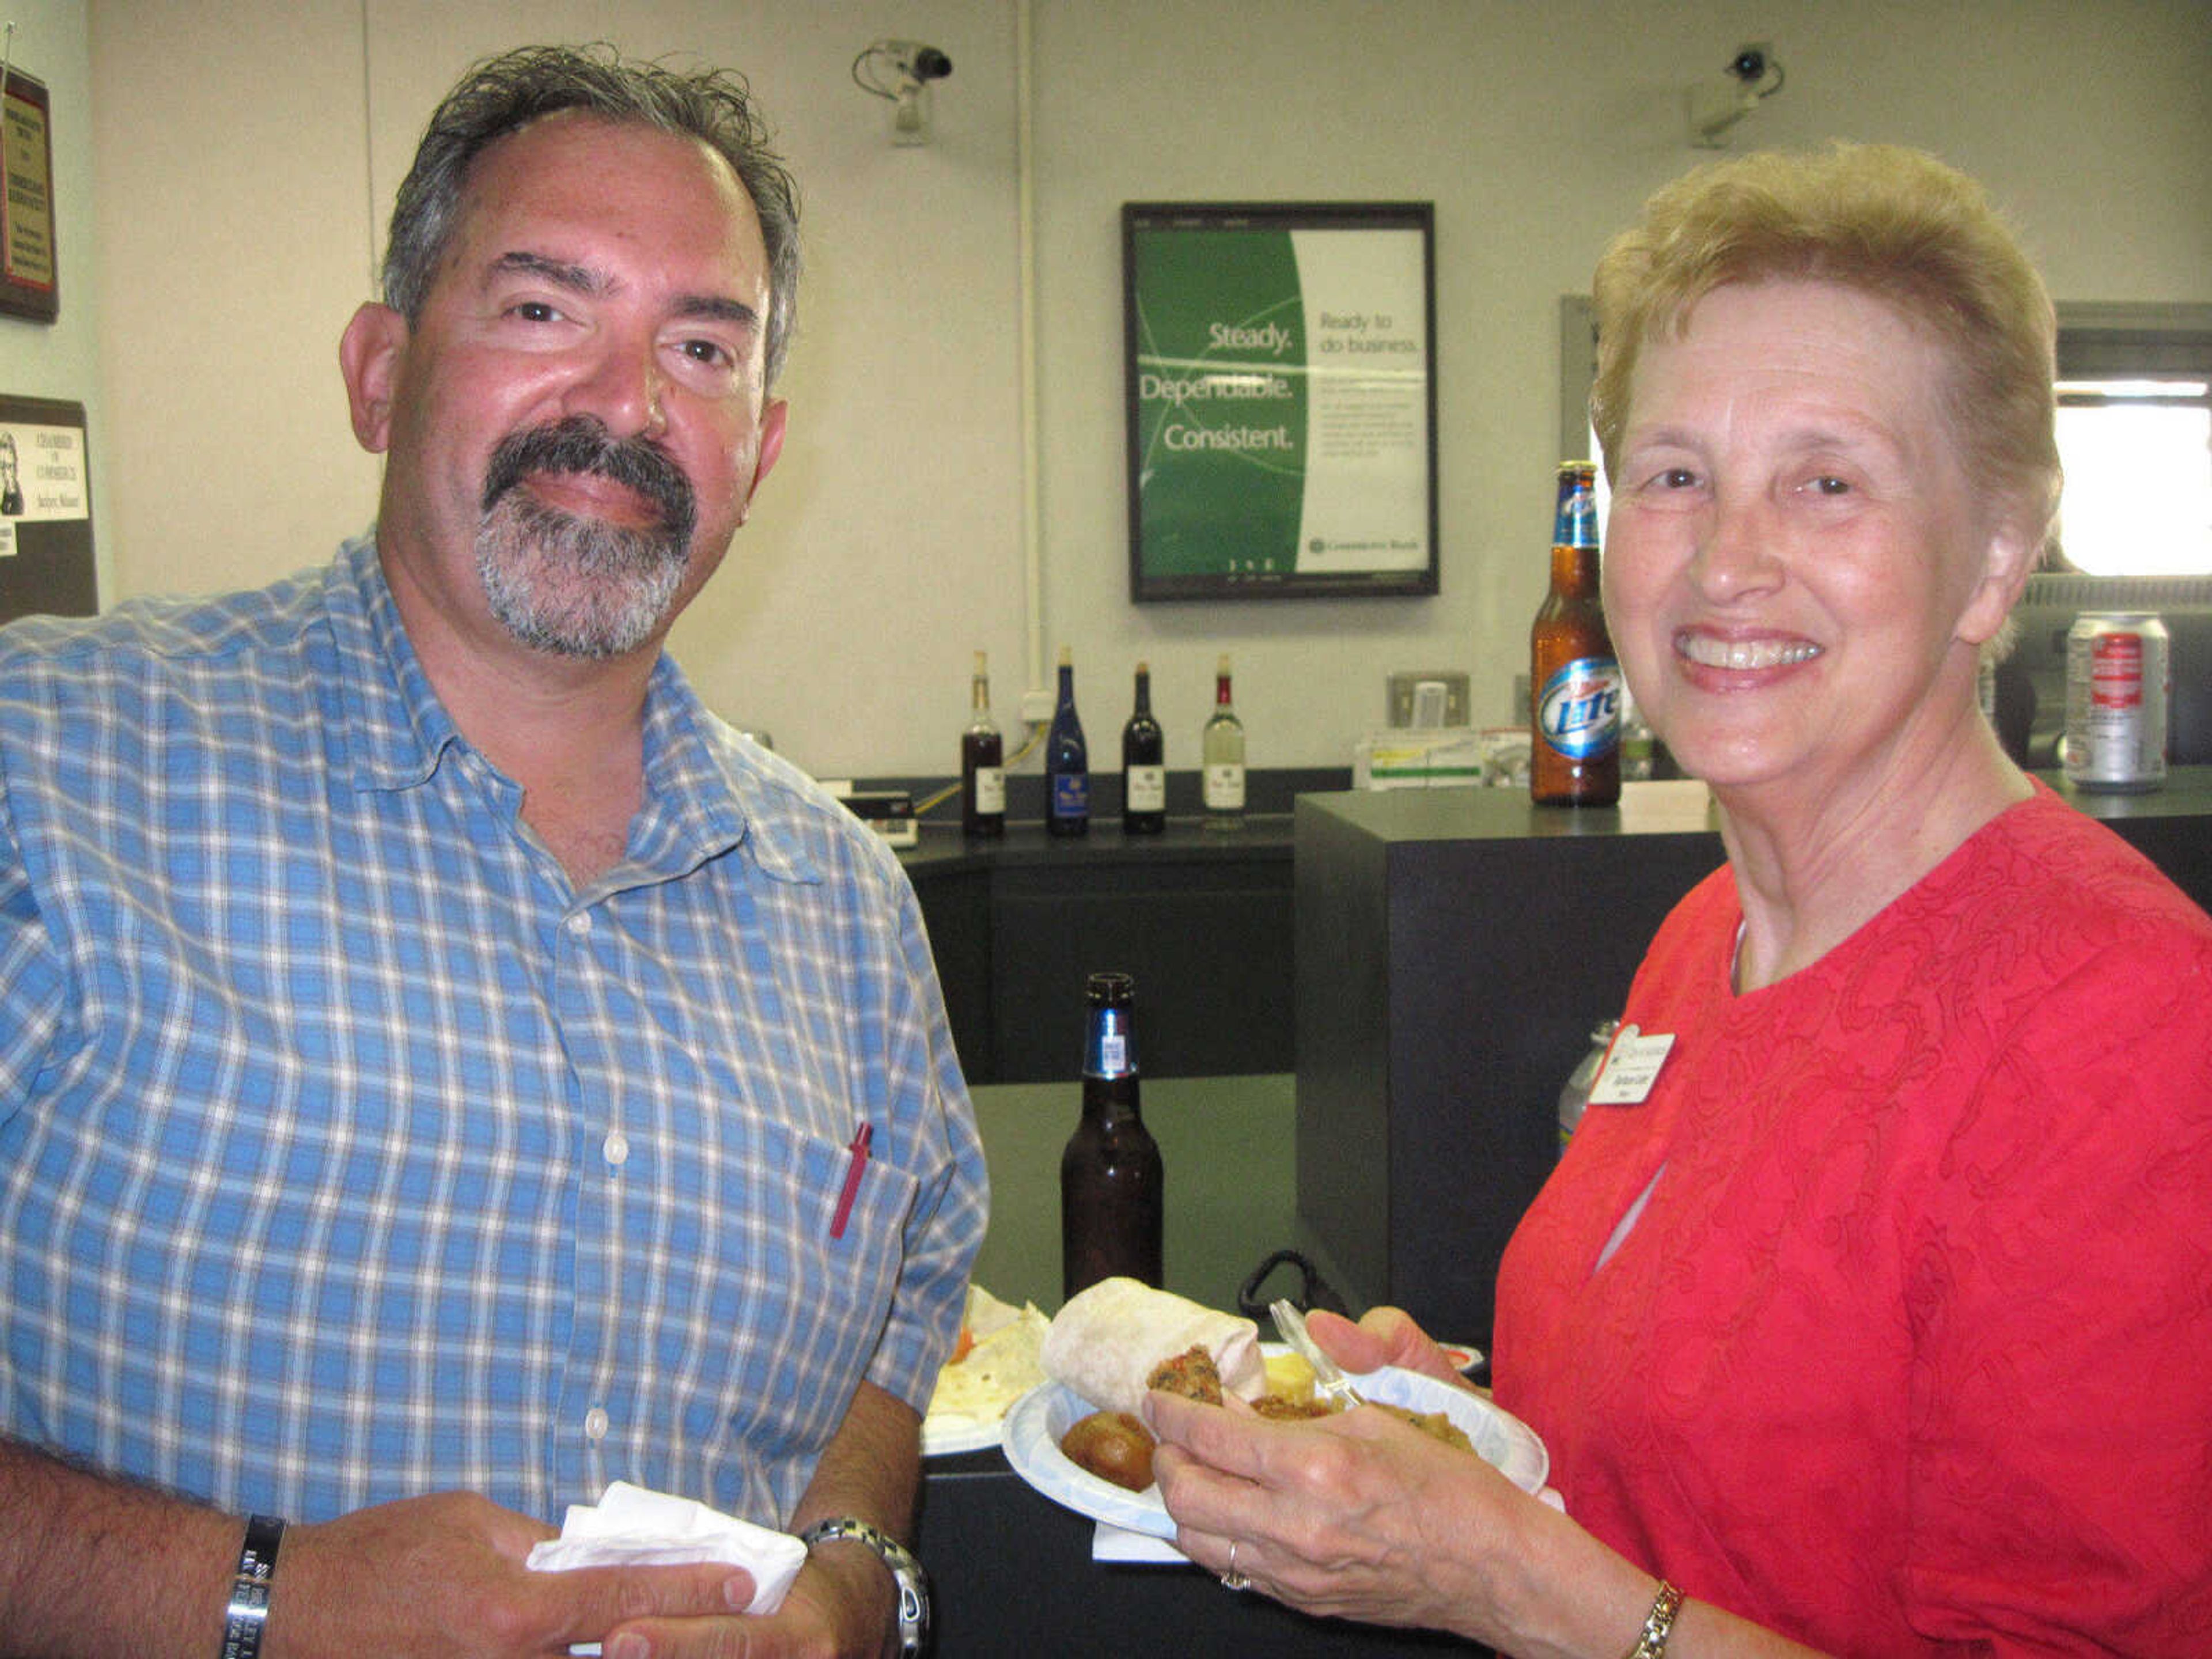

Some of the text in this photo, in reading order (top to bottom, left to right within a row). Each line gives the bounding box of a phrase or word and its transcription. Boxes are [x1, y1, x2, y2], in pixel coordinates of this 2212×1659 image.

[1320, 312, 1393, 334] Ready to
[1209, 322, 1293, 355] Steady.
[1320, 335, 1344, 354] do
[1139, 374, 1293, 406] Dependable.
[1165, 422, 1293, 451] Consistent.
